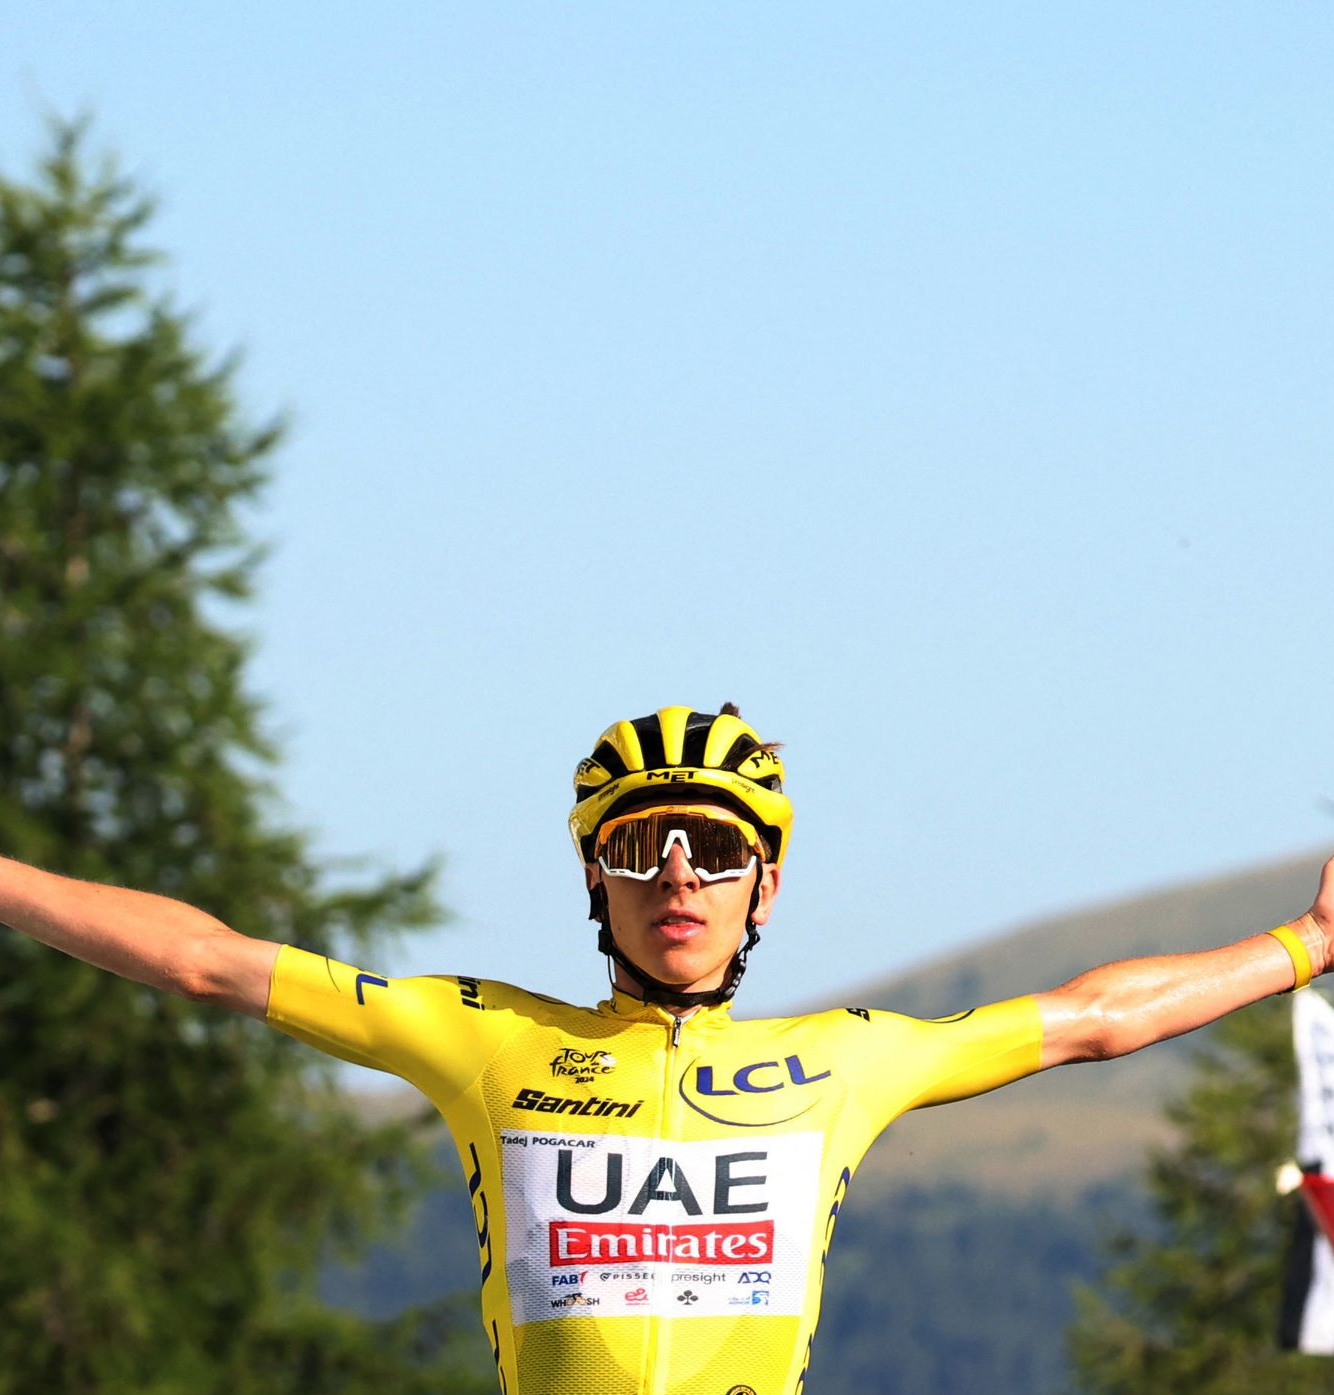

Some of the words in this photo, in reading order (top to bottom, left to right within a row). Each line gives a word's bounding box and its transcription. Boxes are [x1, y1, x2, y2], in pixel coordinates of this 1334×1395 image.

[646, 769, 699, 783] MET
[696, 1054, 831, 1096] LCL
[511, 1088, 644, 1118] Santini
[500, 1136, 528, 1147] Tadej
[532, 1137, 596, 1148] POGACAR
[556, 1149, 769, 1216] UAE
[554, 1226, 768, 1260] Emirates
[671, 1272, 727, 1285] presight
